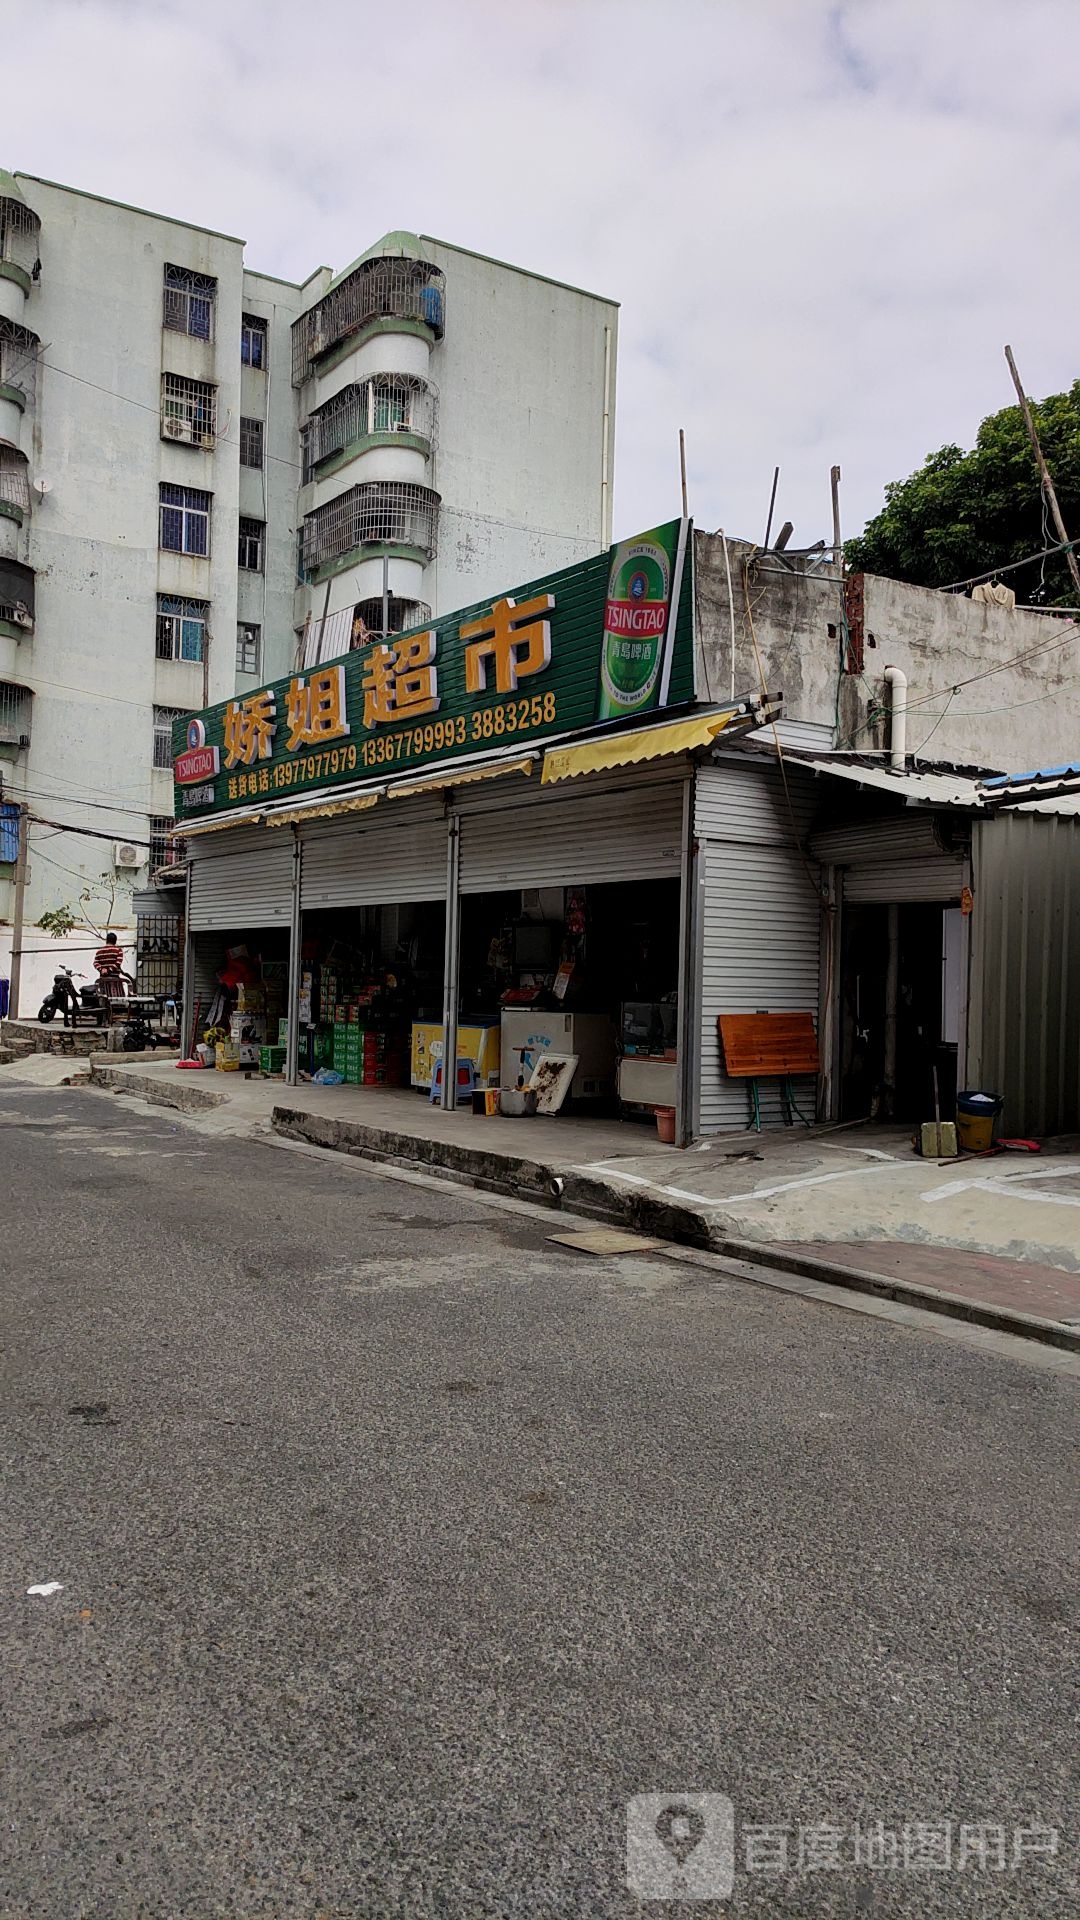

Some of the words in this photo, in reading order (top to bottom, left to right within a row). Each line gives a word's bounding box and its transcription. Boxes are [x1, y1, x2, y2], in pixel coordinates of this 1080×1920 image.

[608, 605, 665, 629] TSINGTAO
[223, 594, 555, 769] 娇姐超市
[362, 716, 466, 766] 13367799993
[472, 692, 556, 740] 3883258
[178, 753, 212, 777] TSINGTAO
